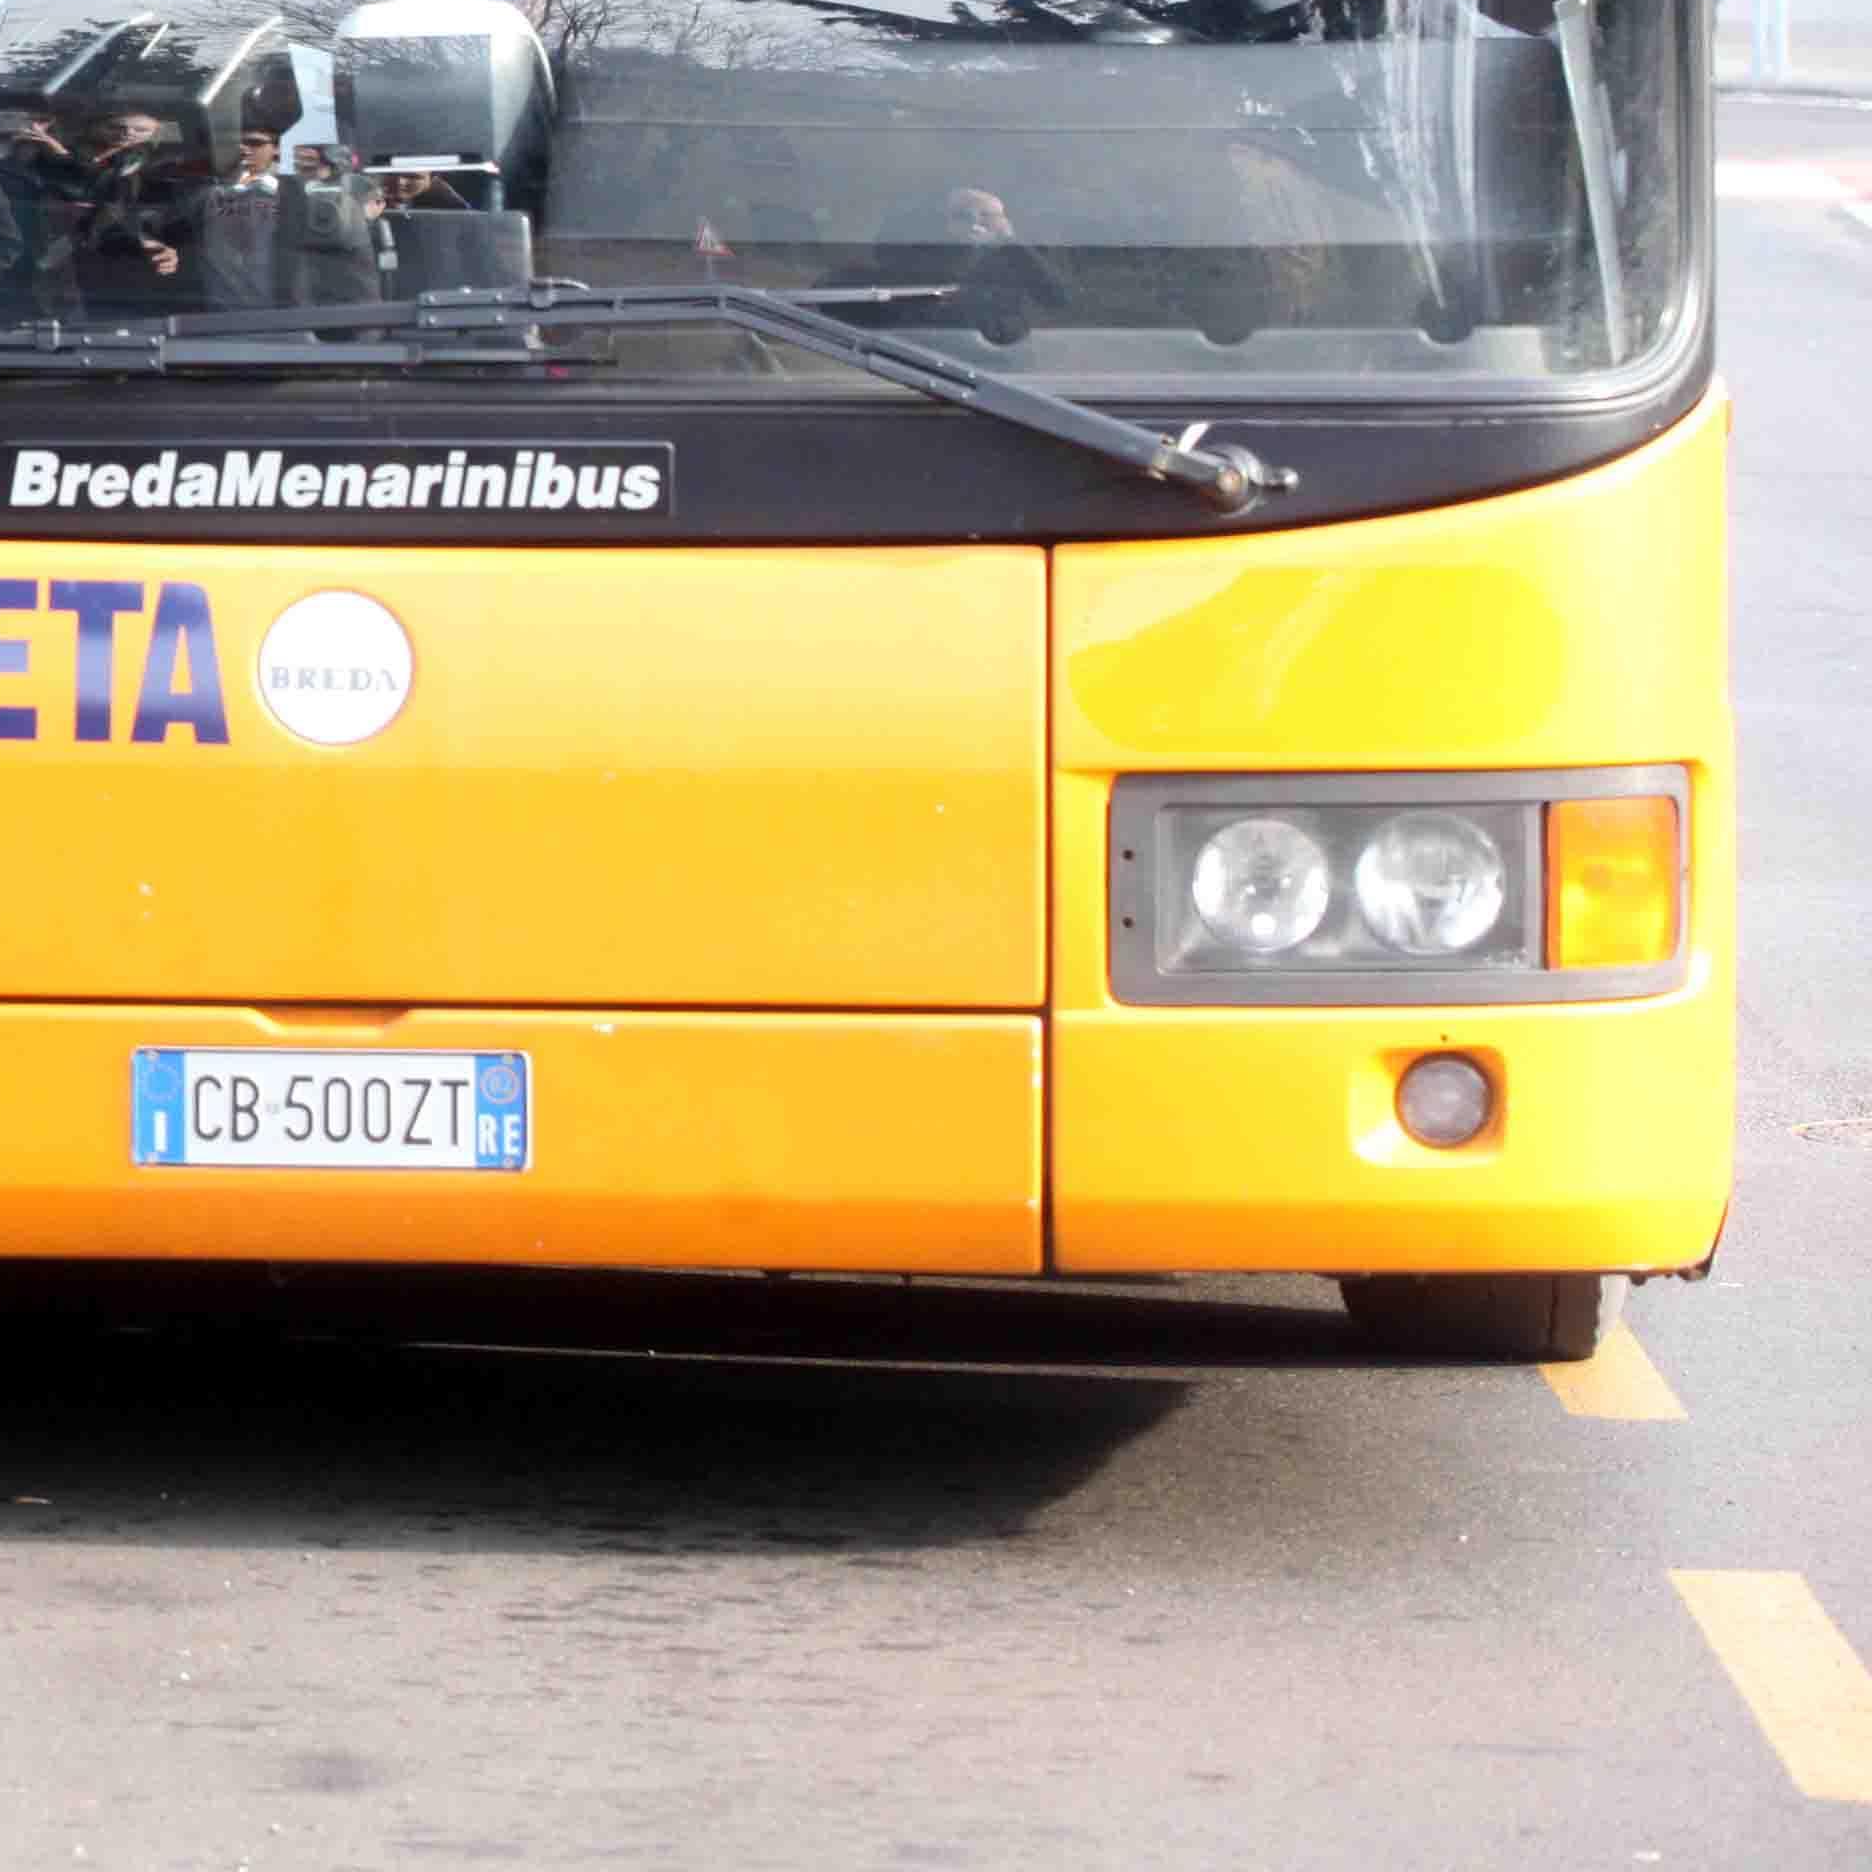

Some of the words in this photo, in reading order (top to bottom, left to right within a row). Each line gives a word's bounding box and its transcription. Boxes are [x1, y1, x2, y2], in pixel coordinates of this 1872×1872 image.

[7, 449, 662, 510] BredaMenarinibus
[270, 665, 399, 692] BREDA
[478, 1113, 521, 1156] RE
